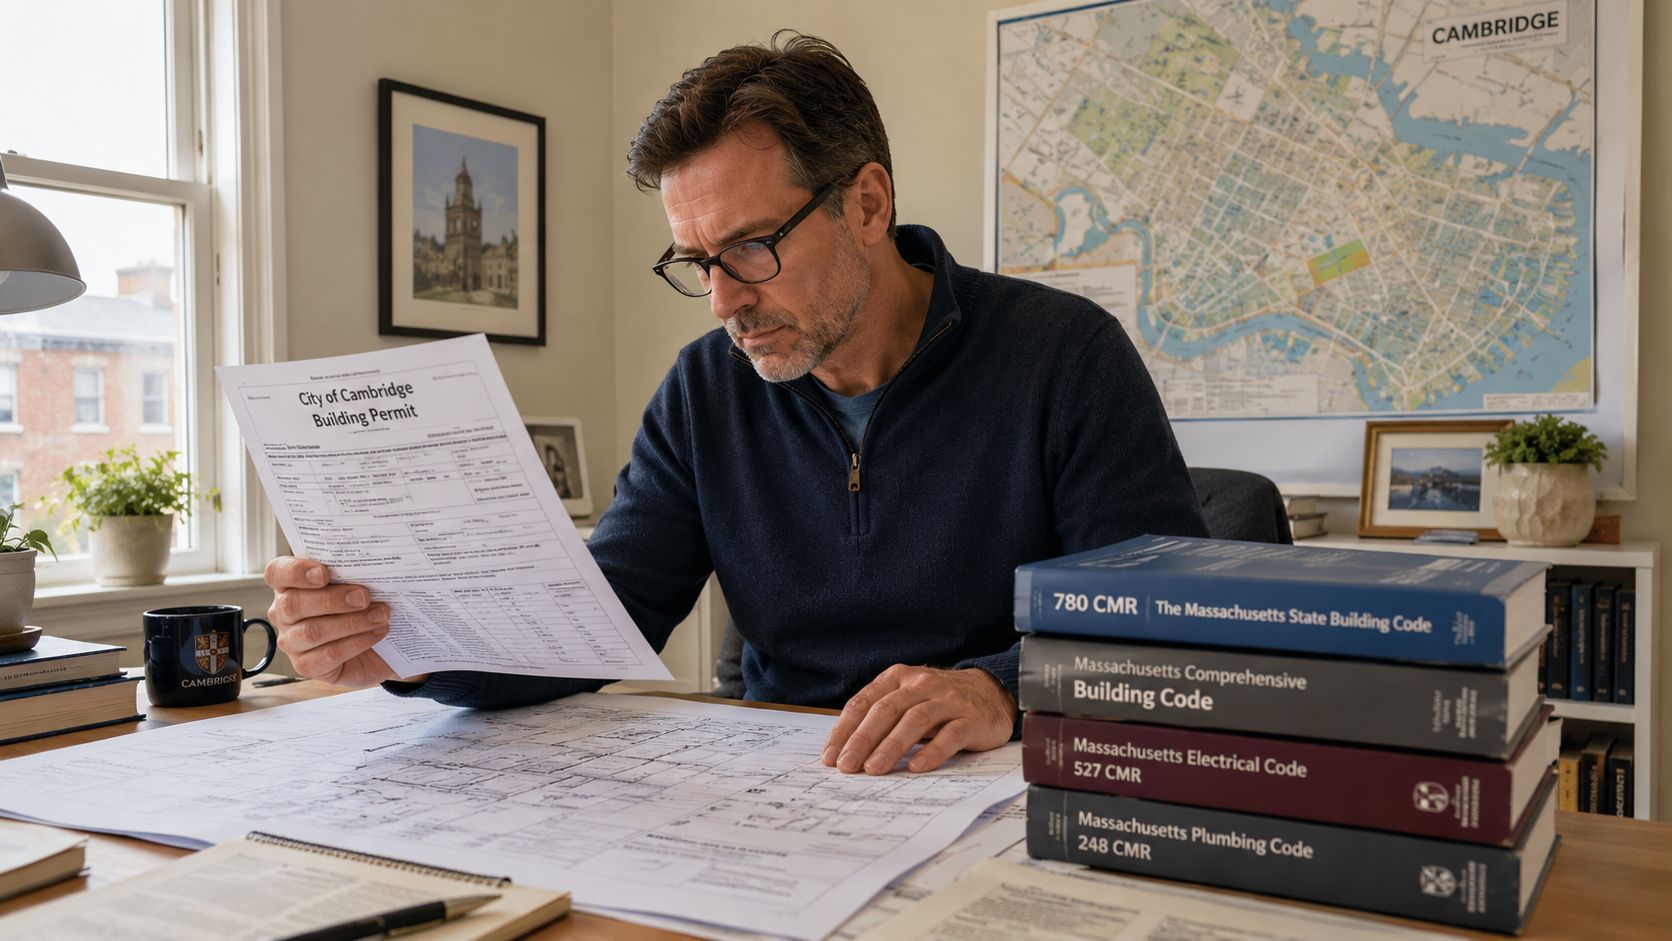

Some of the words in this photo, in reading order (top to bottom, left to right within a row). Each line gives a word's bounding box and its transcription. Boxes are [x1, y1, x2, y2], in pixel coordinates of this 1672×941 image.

[1432, 11, 1559, 44] CAMBRIDGE
[298, 391, 323, 408] City
[325, 389, 339, 403] of
[340, 382, 414, 402] Cambridge
[312, 411, 369, 427] Building
[368, 403, 418, 422] Permit
[1053, 592, 1088, 612] 780
[1092, 594, 1138, 615] CMR
[1155, 600, 1182, 616] The
[1184, 602, 1286, 623] Massachusetts
[1288, 607, 1327, 626] State
[1329, 611, 1390, 634] Building
[1392, 615, 1432, 633] Code
[1074, 656, 1181, 679] Massachusetts
[1184, 665, 1307, 690] Comprehensive
[1073, 679, 1155, 709] Building
[1160, 688, 1213, 711] Code
[1073, 737, 1183, 764] Massachusetts
[1187, 749, 1260, 773] Electrical
[1264, 758, 1308, 778] Code
[1073, 760, 1101, 778] 527
[1105, 764, 1142, 783] CMR
[1078, 811, 1187, 840] Massachusetts
[1191, 826, 1266, 856] Plumbing
[1270, 837, 1314, 859] Code
[1078, 835, 1108, 853] 248
[1112, 840, 1152, 860] CMR
